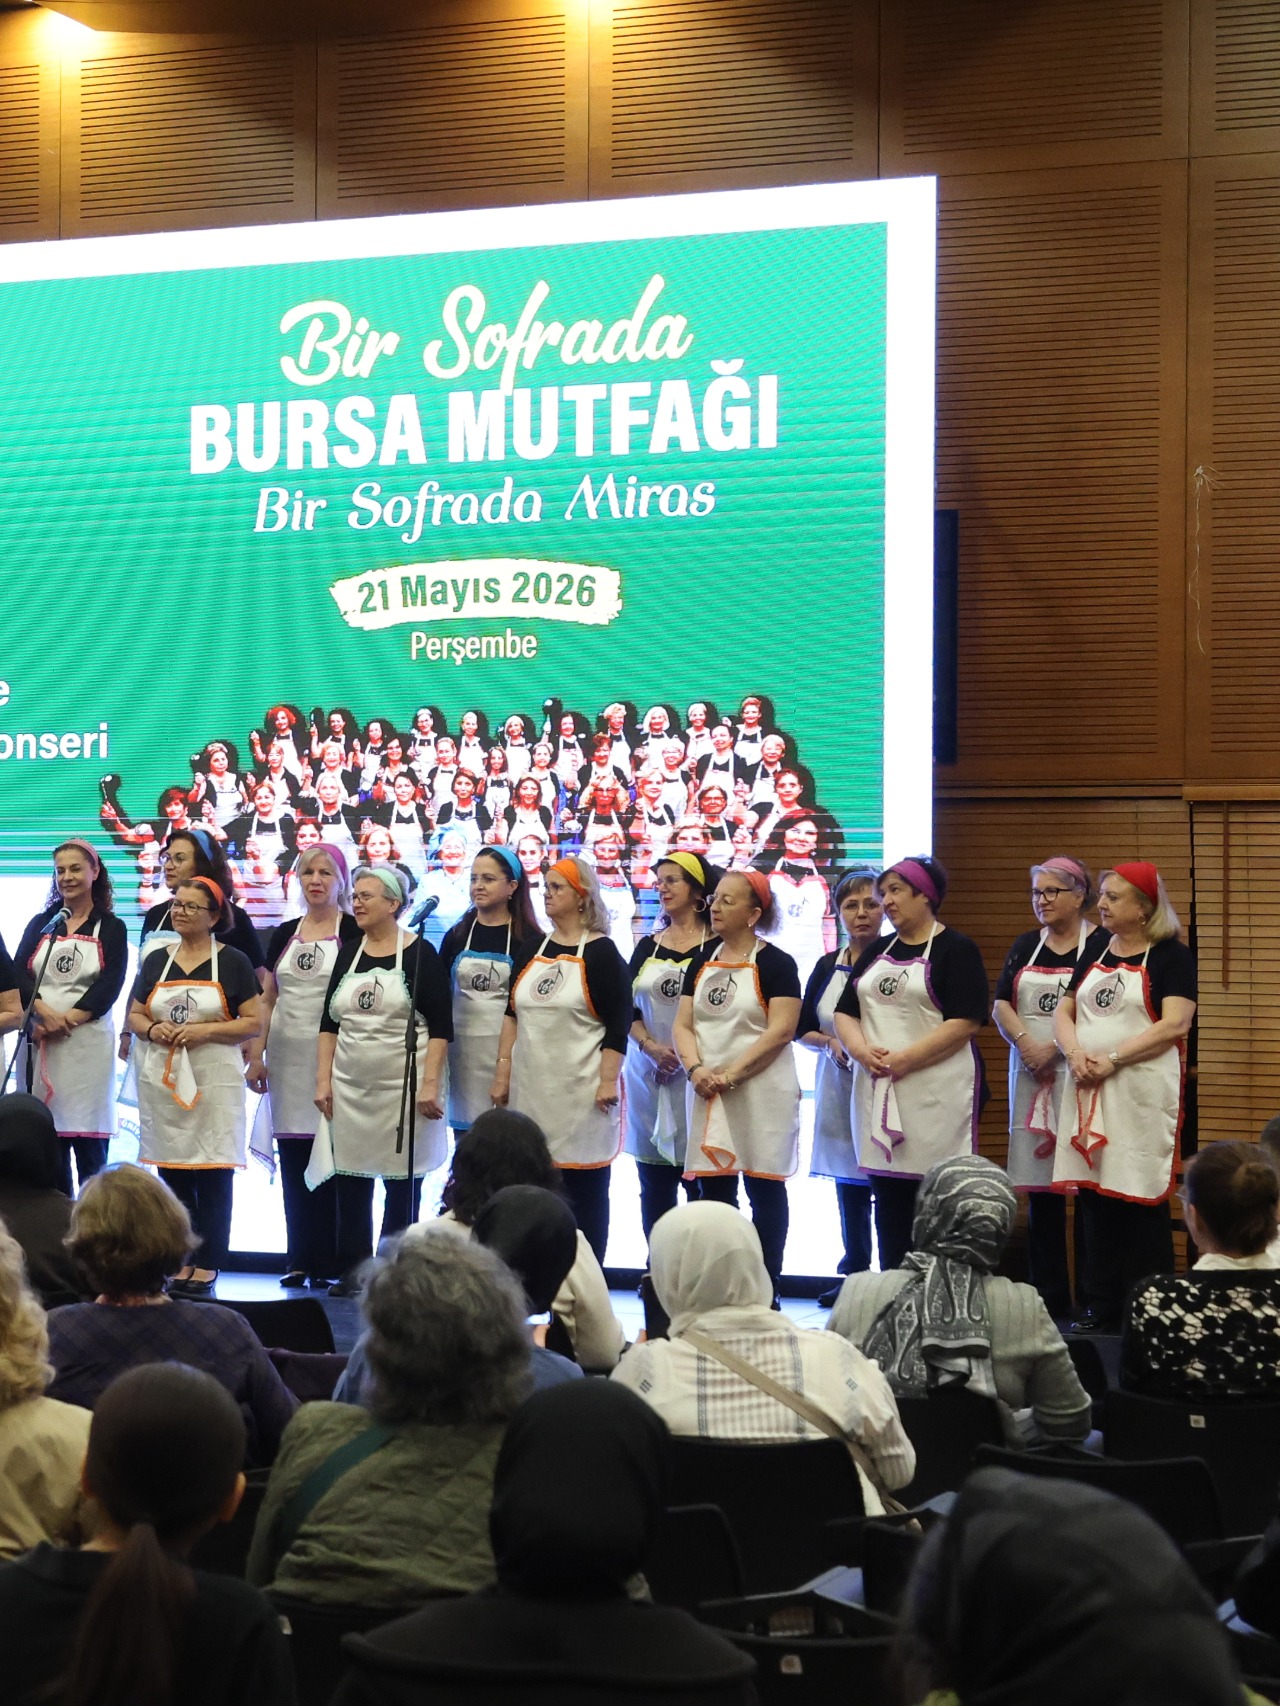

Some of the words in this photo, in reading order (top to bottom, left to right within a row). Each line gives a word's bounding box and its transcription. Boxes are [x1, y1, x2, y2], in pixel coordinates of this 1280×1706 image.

[279, 299, 400, 386] Bir
[423, 273, 695, 393] Sofrada
[189, 394, 428, 475] BURSA
[448, 358, 779, 463] MUTFAĞI
[252, 486, 327, 534] Bir
[347, 476, 543, 544] Sofrada
[564, 472, 717, 521] Miras
[356, 580, 391, 614] 21
[401, 570, 501, 613] Mayıs
[511, 570, 597, 608] 2026
[410, 628, 538, 665] Perşembe
